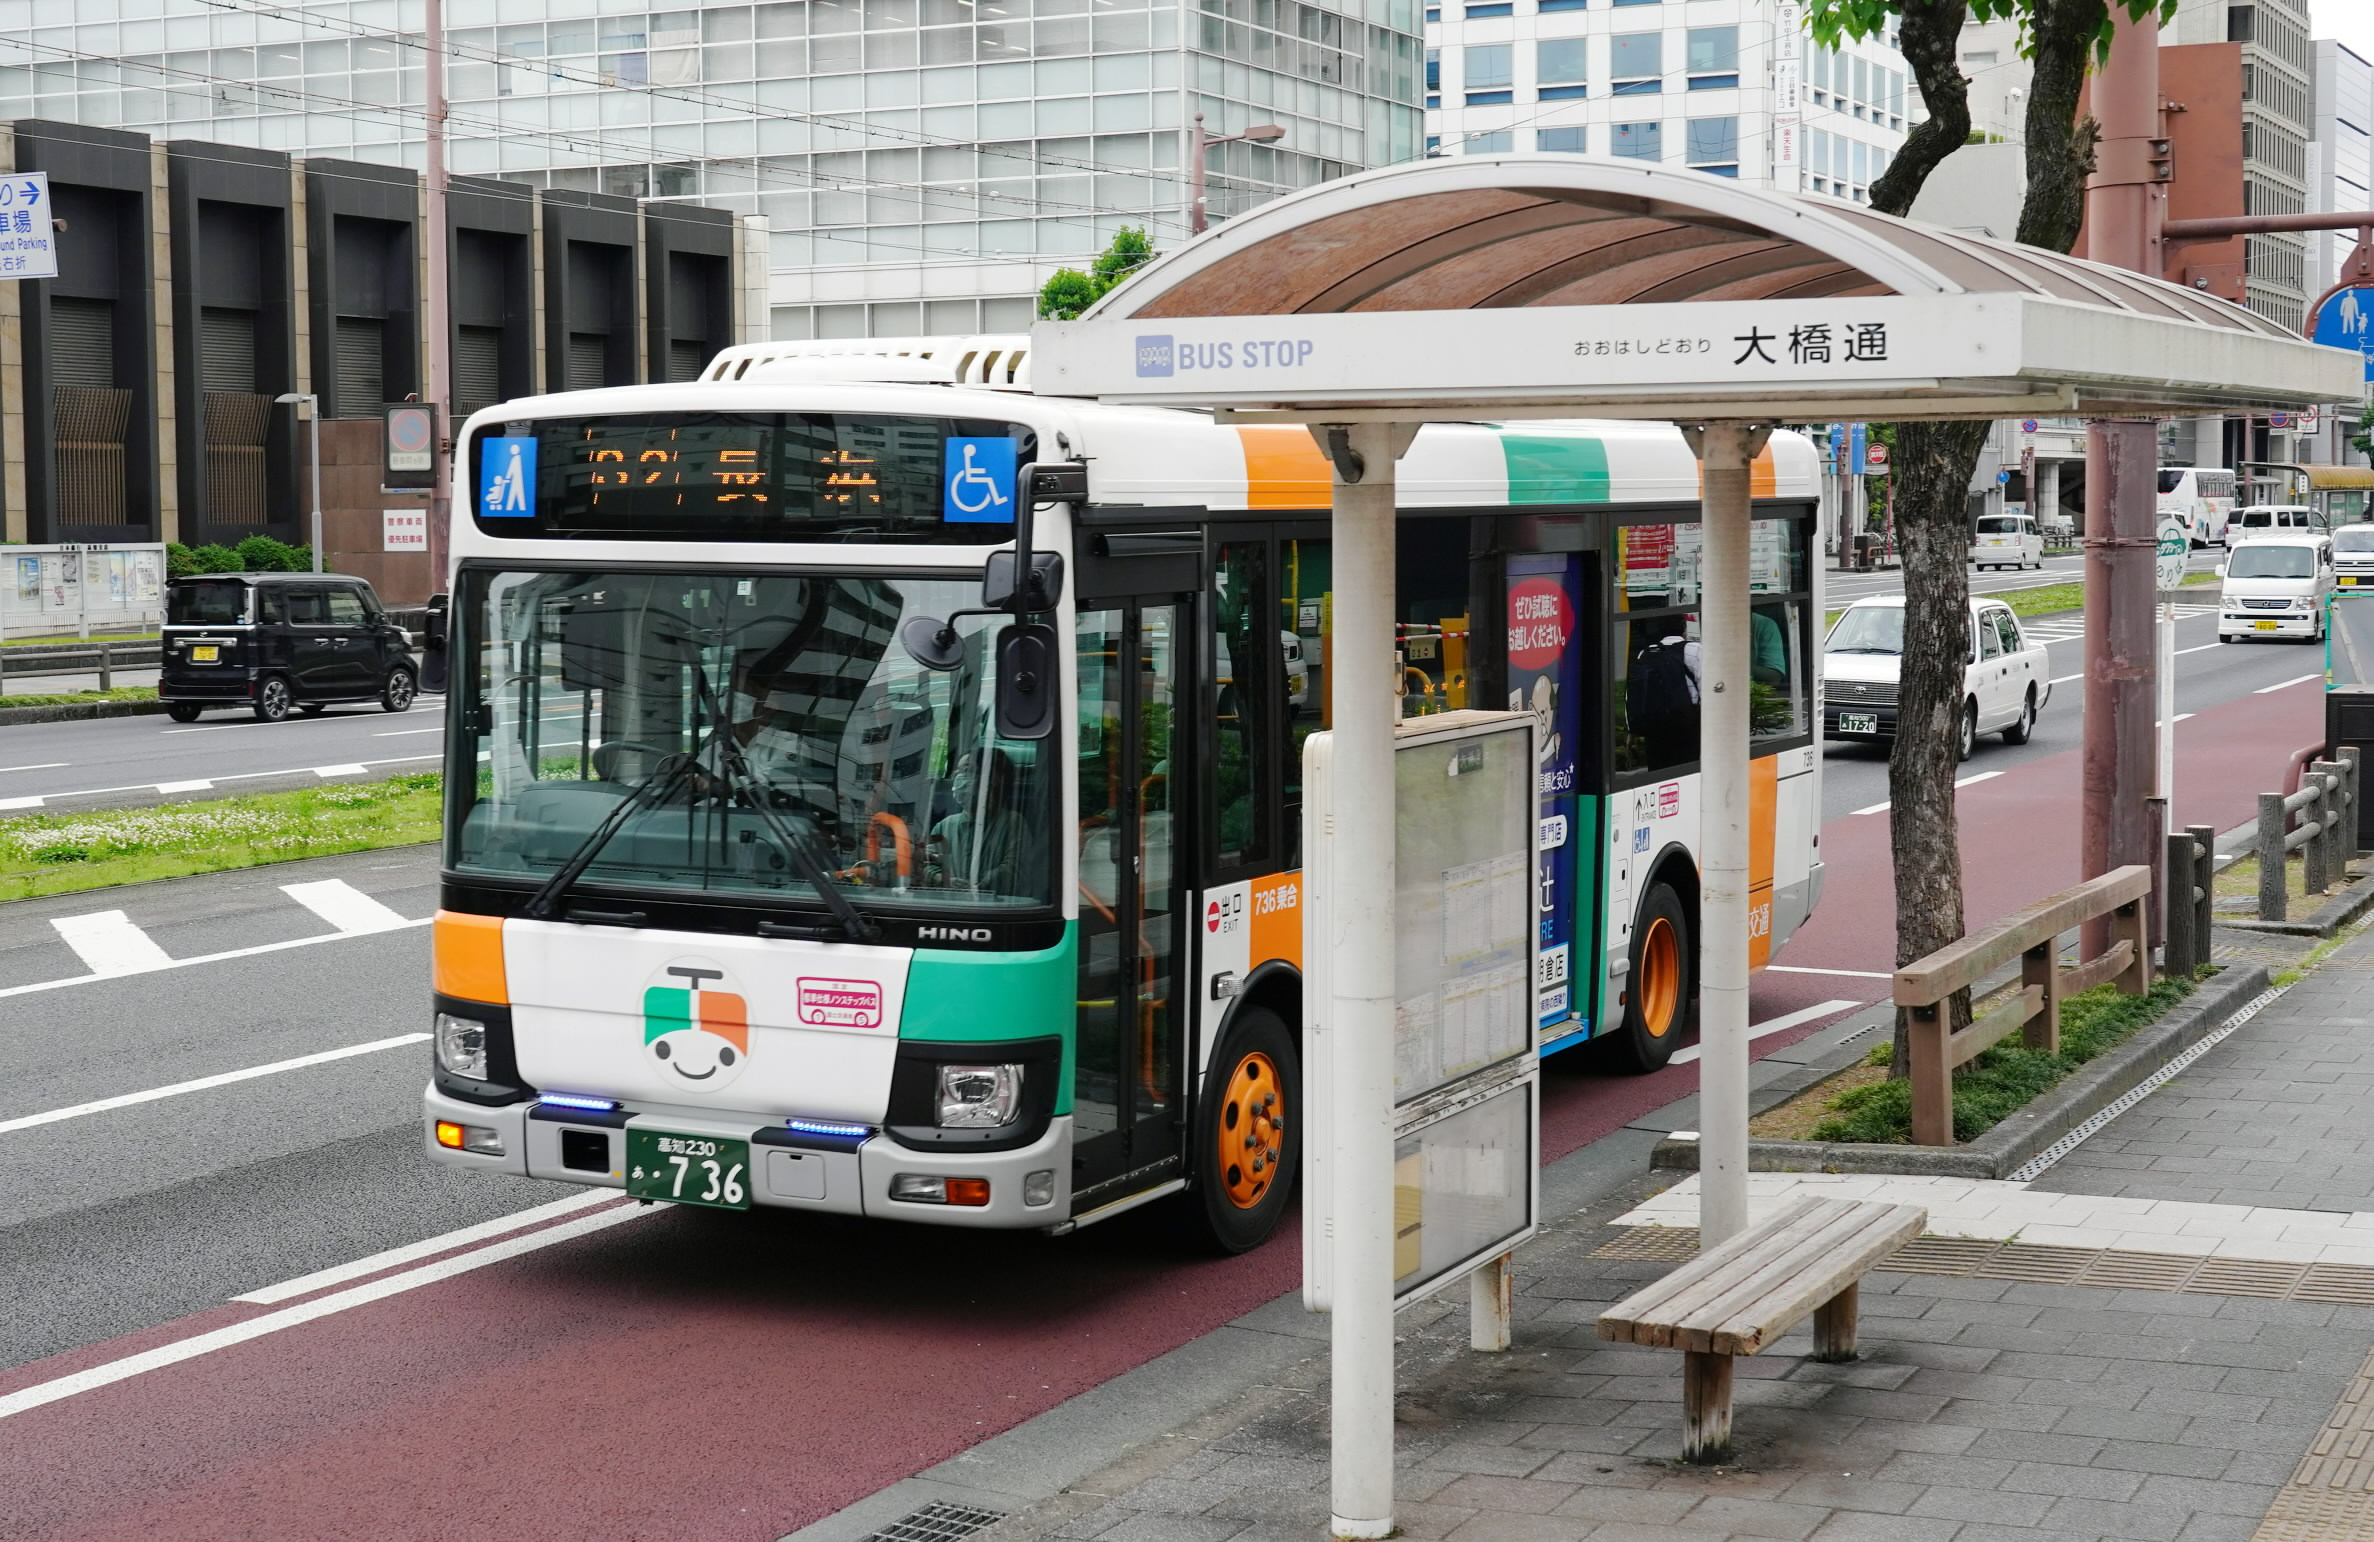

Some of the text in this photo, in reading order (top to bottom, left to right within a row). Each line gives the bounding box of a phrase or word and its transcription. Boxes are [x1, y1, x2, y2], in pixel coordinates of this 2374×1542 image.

[18, 237, 48, 251] Parking
[0, 255, 26, 271] 右折
[1574, 323, 1888, 366] おおはしどおり 大橋通
[1178, 340, 1313, 370] BUS STOP
[1515, 594, 1558, 620] ぜひ試聴に
[1849, 721, 1875, 731] 17-20
[1643, 792, 1656, 810] 入口
[1540, 822, 1562, 845] 専門店
[1222, 893, 1241, 917] 出口
[918, 927, 992, 942] HINO
[1223, 919, 1239, 933] EXIT
[1539, 920, 1553, 941] RE
[657, 1137, 716, 1157] 高知230
[631, 1165, 645, 1180] あ
